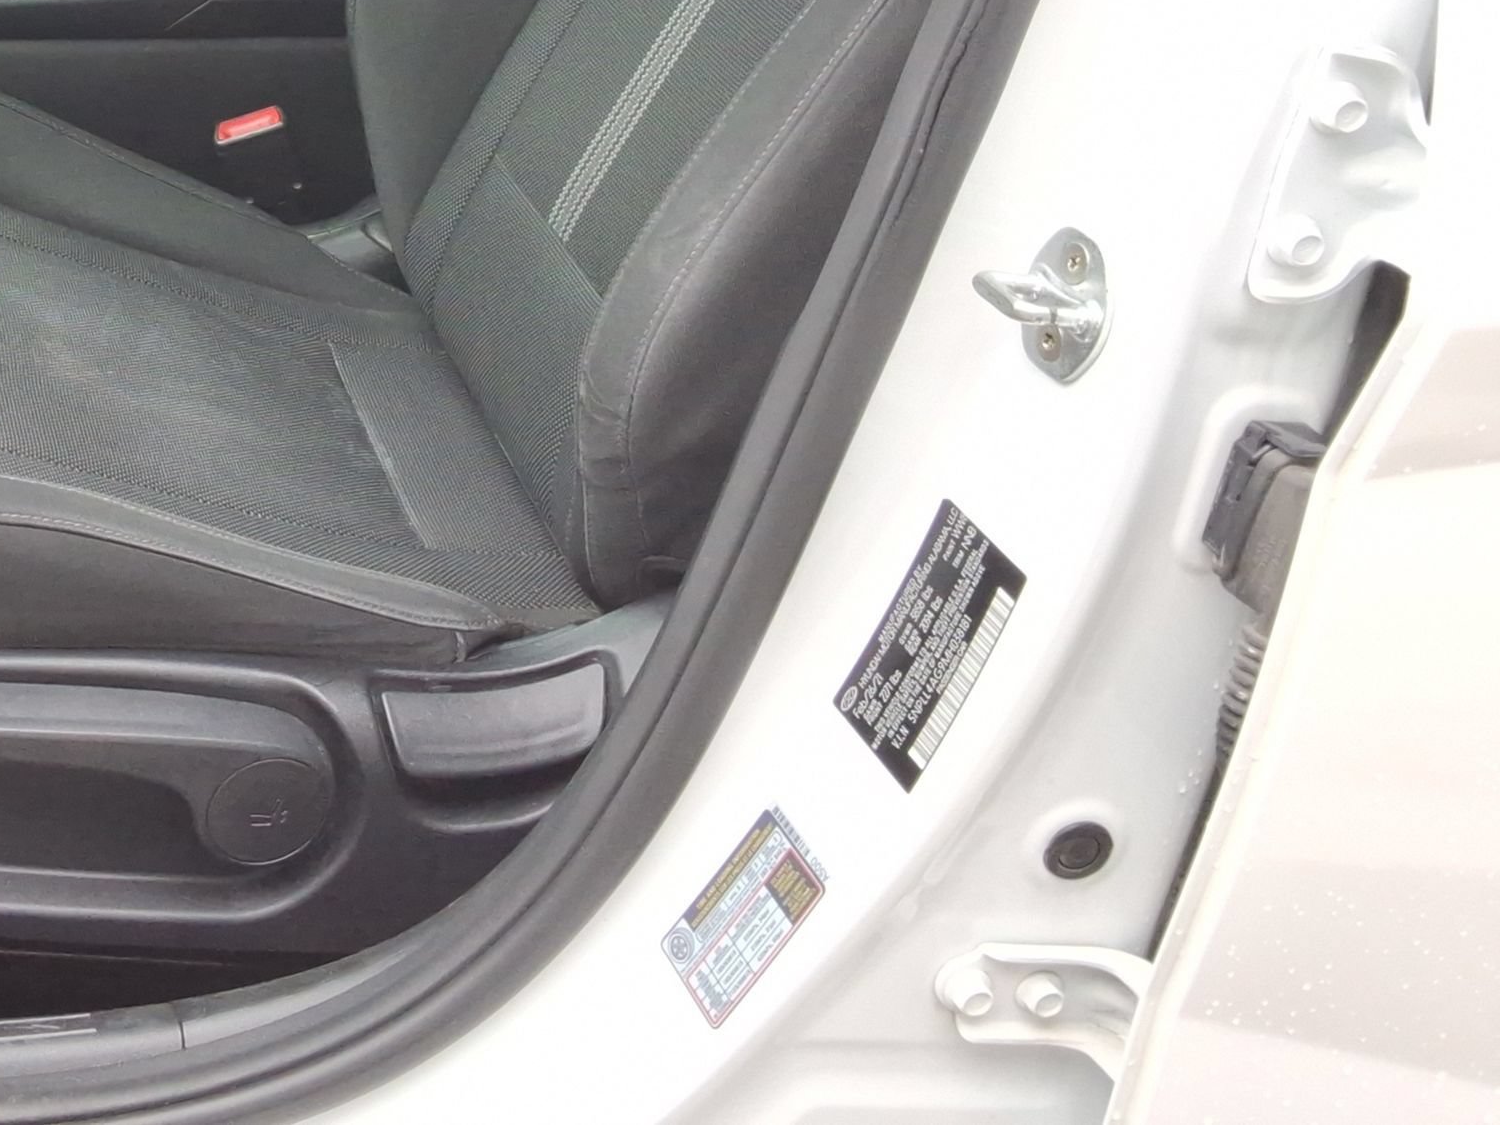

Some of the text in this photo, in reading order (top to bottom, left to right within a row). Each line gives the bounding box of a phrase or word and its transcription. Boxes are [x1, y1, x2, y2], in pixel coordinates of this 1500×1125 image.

[858, 652, 882, 690] HYUNDAI
[878, 625, 897, 657] MOTOR
[893, 561, 932, 630] MANUFACTURING
[946, 506, 958, 526] LLC
[920, 583, 934, 602] lbs
[889, 666, 902, 687] lbs
[930, 593, 944, 613] lbs
